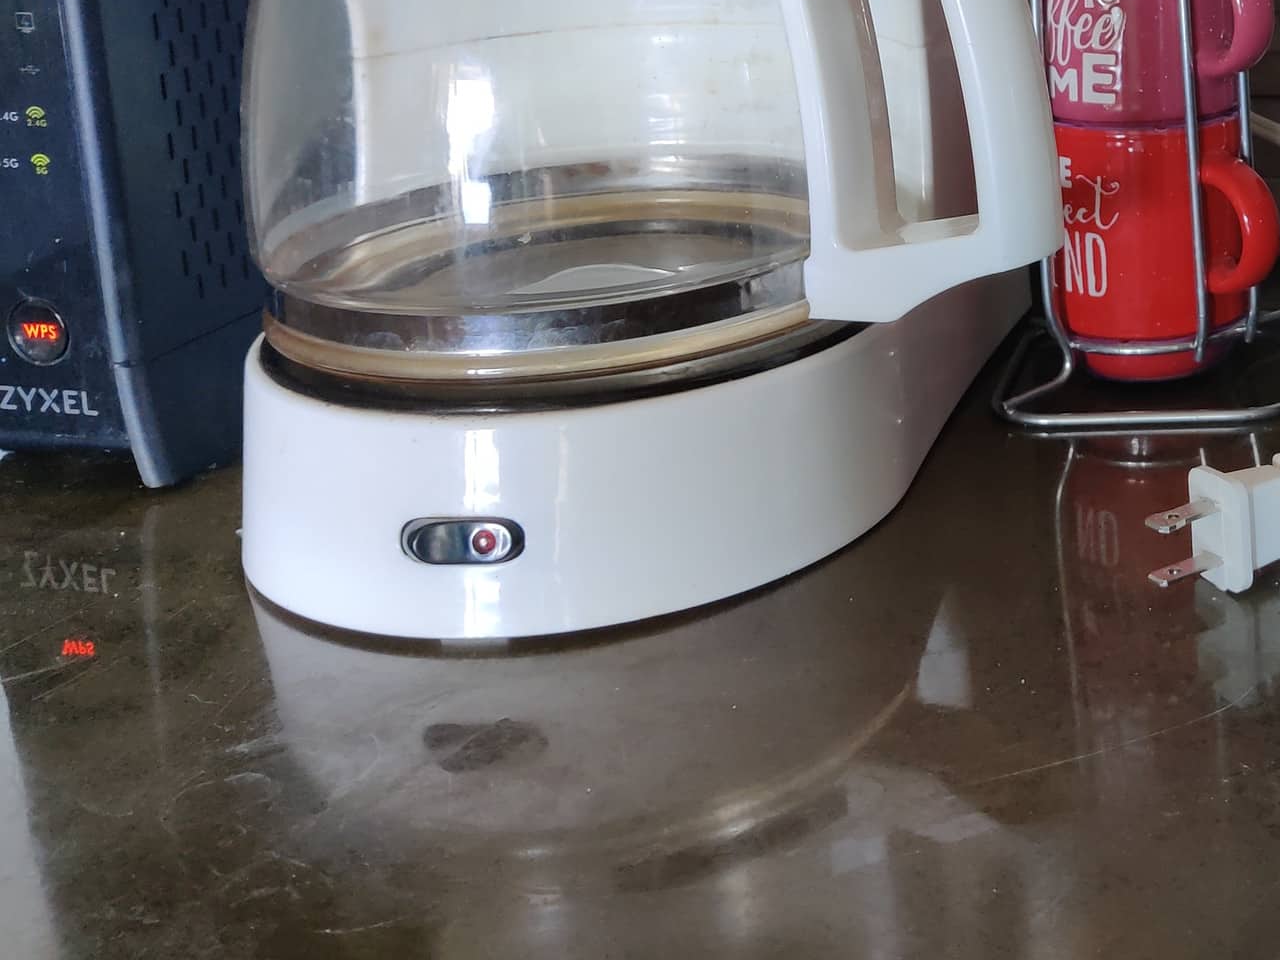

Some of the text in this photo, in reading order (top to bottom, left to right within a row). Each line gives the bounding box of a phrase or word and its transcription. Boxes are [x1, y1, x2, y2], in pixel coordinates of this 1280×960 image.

[1052, 227, 1108, 297] ND
[23, 323, 58, 340] WPS
[0, 385, 100, 417] ZYXEL
